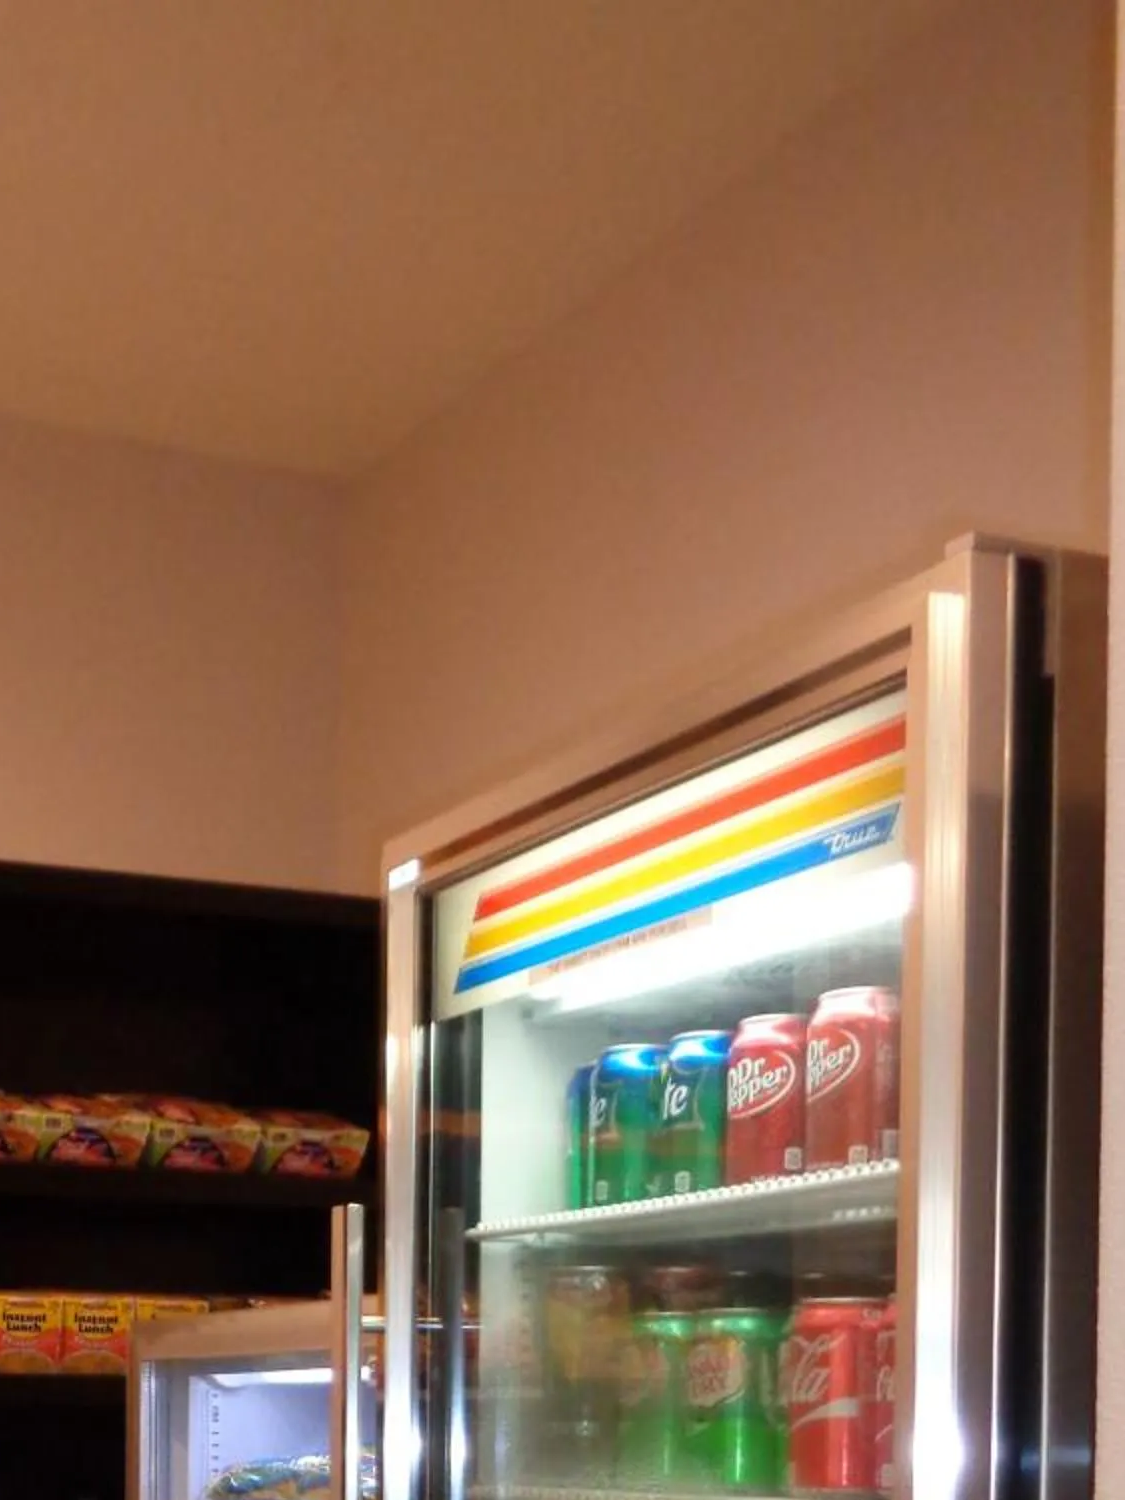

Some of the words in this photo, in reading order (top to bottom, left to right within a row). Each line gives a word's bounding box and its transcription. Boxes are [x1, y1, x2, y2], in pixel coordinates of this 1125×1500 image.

[737, 1056, 766, 1085] Dr
[2, 1310, 47, 1323] Instant
[74, 1310, 119, 1324] Instant
[6, 1321, 43, 1333] Lunch
[78, 1323, 114, 1335] Lunch
